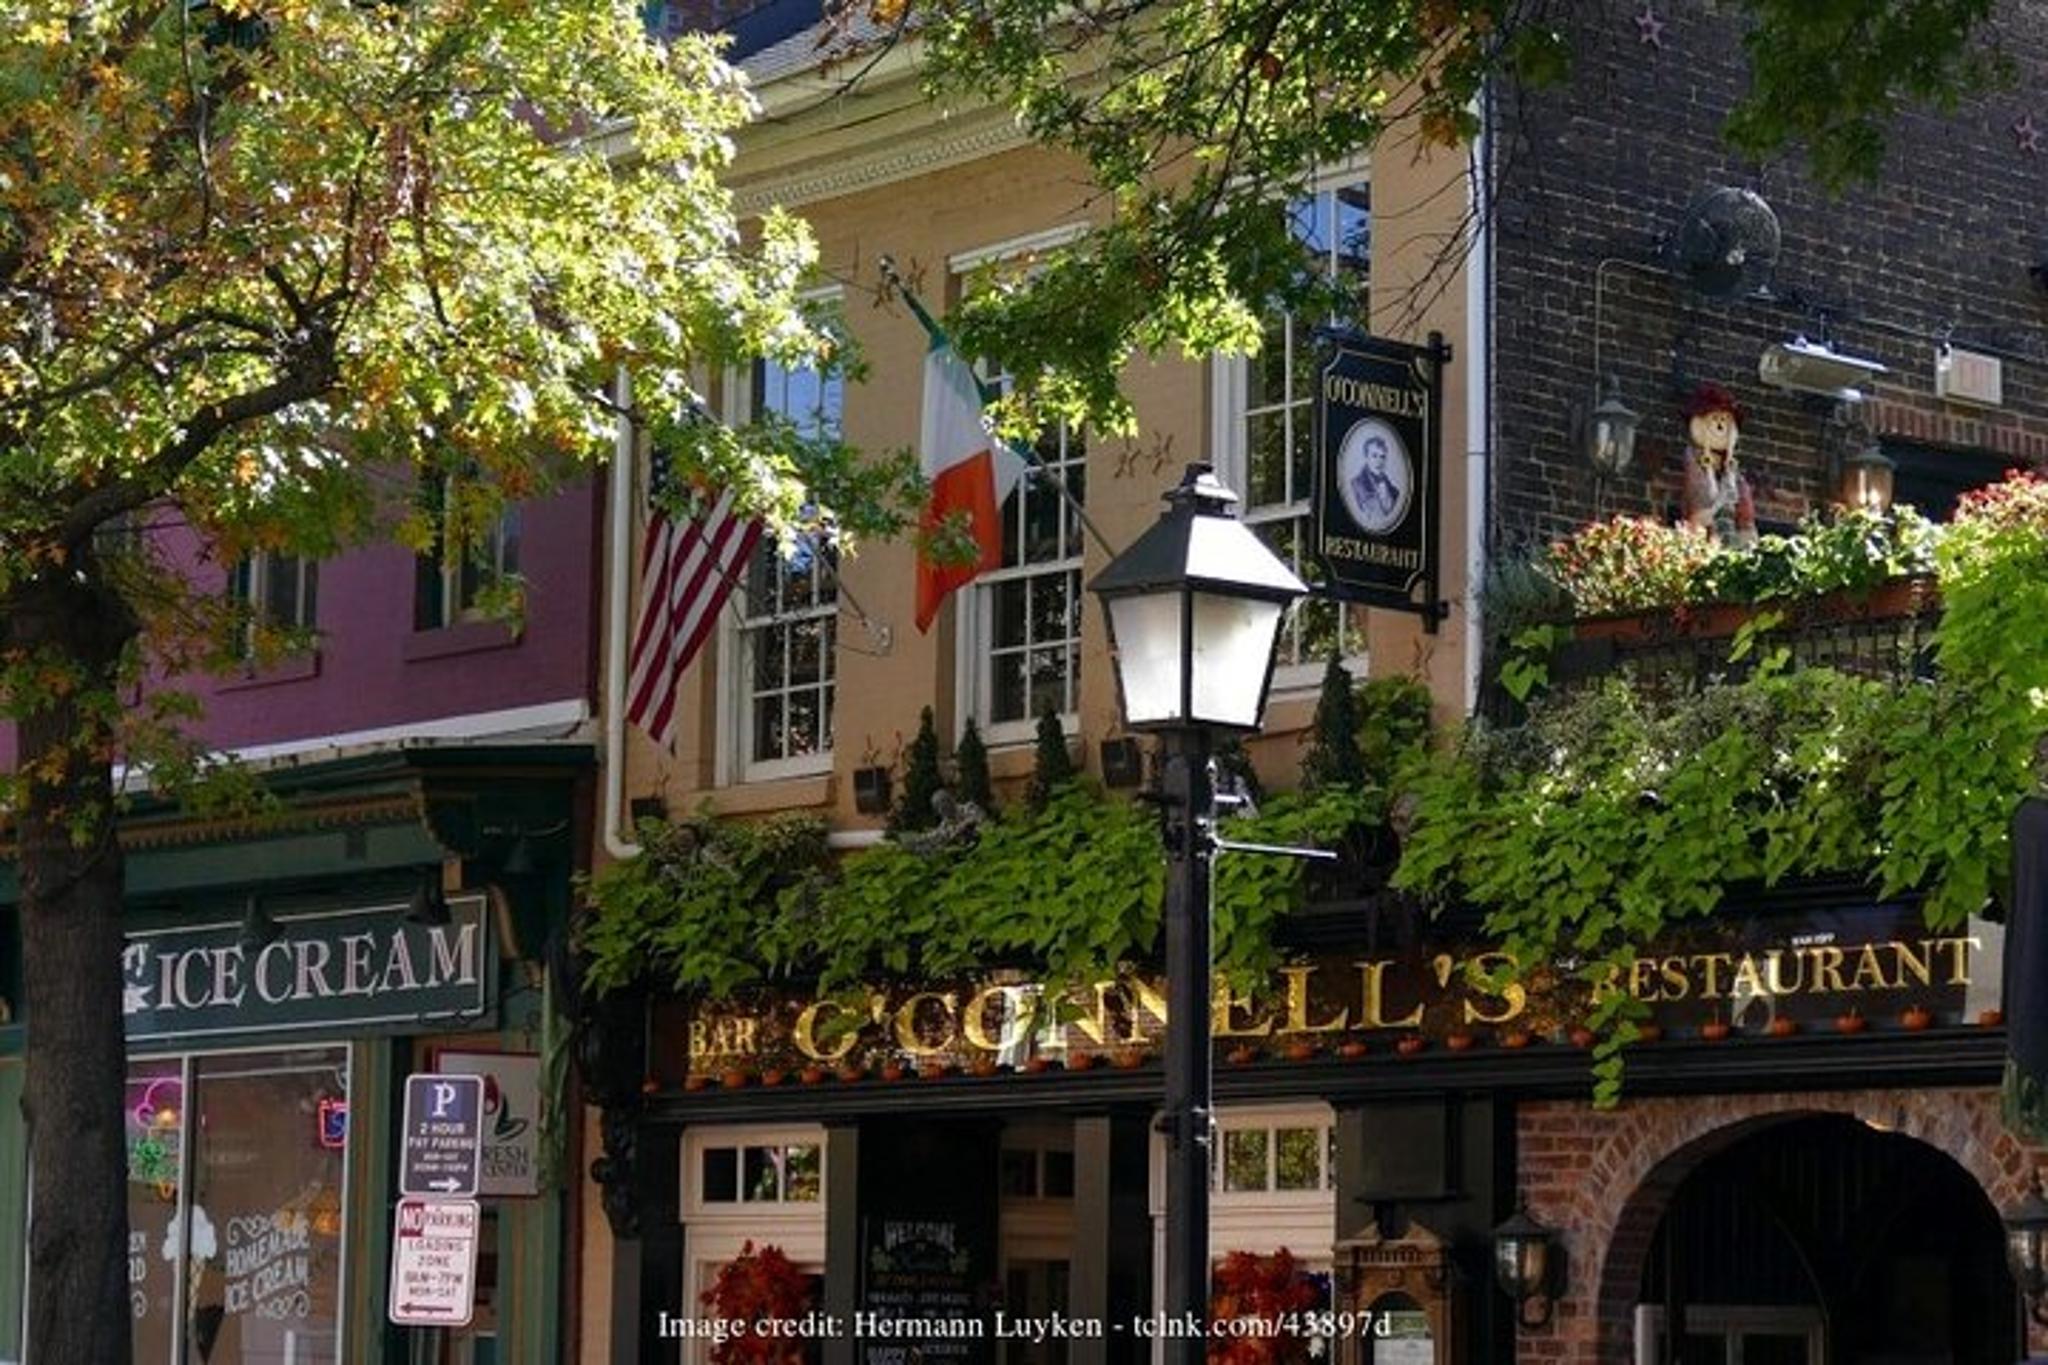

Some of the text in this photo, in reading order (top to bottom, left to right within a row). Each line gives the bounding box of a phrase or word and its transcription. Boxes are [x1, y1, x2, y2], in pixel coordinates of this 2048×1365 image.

[1325, 536, 1417, 569] RESTAURANT
[155, 922, 478, 1009] ICE CREAM
[687, 1016, 757, 1058] BAR
[431, 1082, 456, 1117] P
[419, 1122, 465, 1135] 2 HOUR
[431, 1137, 474, 1151] PARKING
[481, 1145, 530, 1164] RESH
[400, 1206, 475, 1231] NO PARKING
[226, 1215, 310, 1280] HOMEMADE
[409, 1240, 464, 1252] LOADING
[417, 1254, 450, 1268] ZONE
[224, 1255, 309, 1315] ICE CREAM
